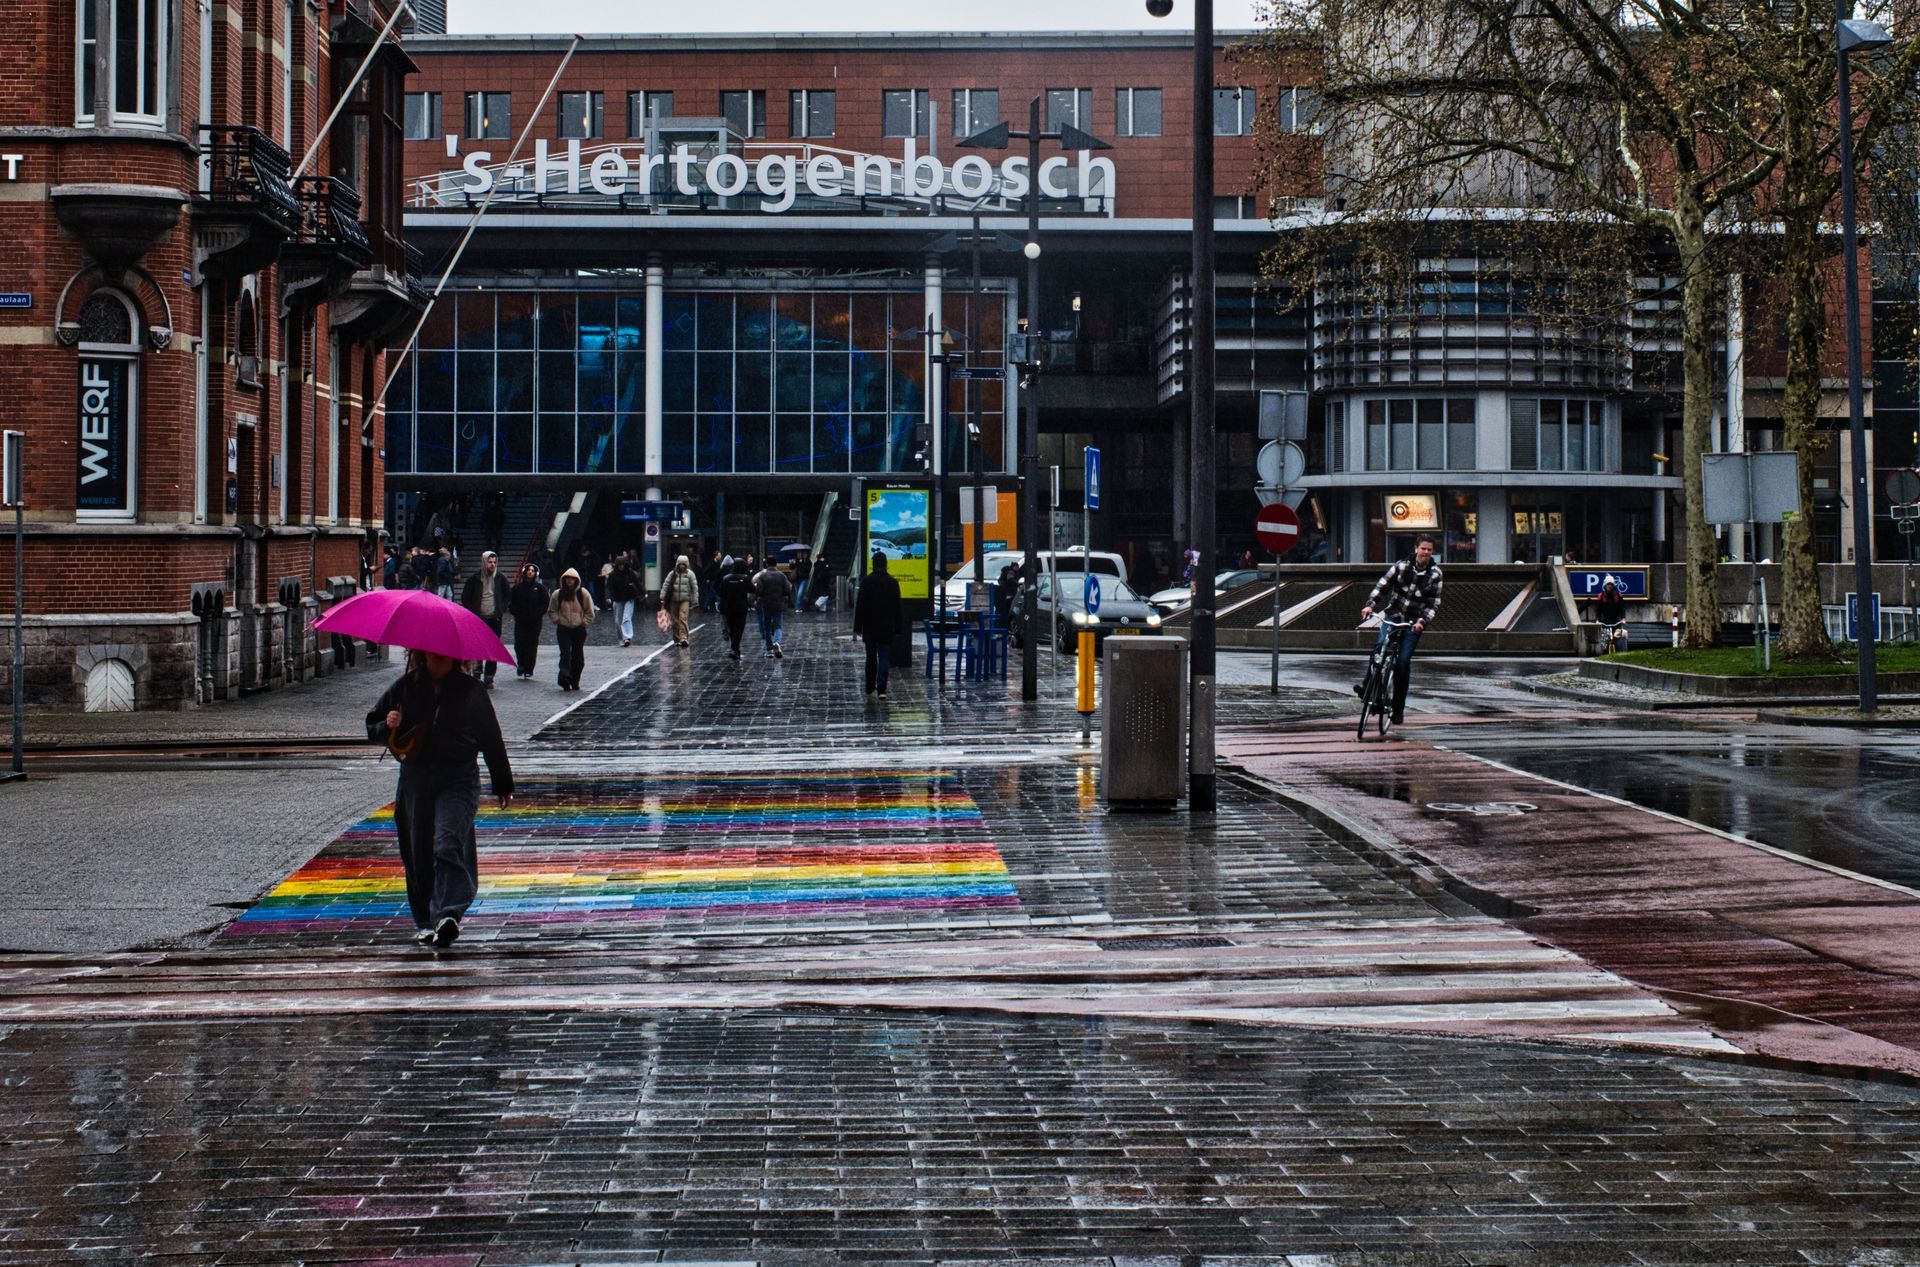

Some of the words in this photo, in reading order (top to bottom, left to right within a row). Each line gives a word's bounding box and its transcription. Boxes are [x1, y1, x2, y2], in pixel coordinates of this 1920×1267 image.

[2, 154, 24, 180] T
[446, 134, 1116, 213] 's-Hertogenbosch
[1586, 574, 1600, 593] P
